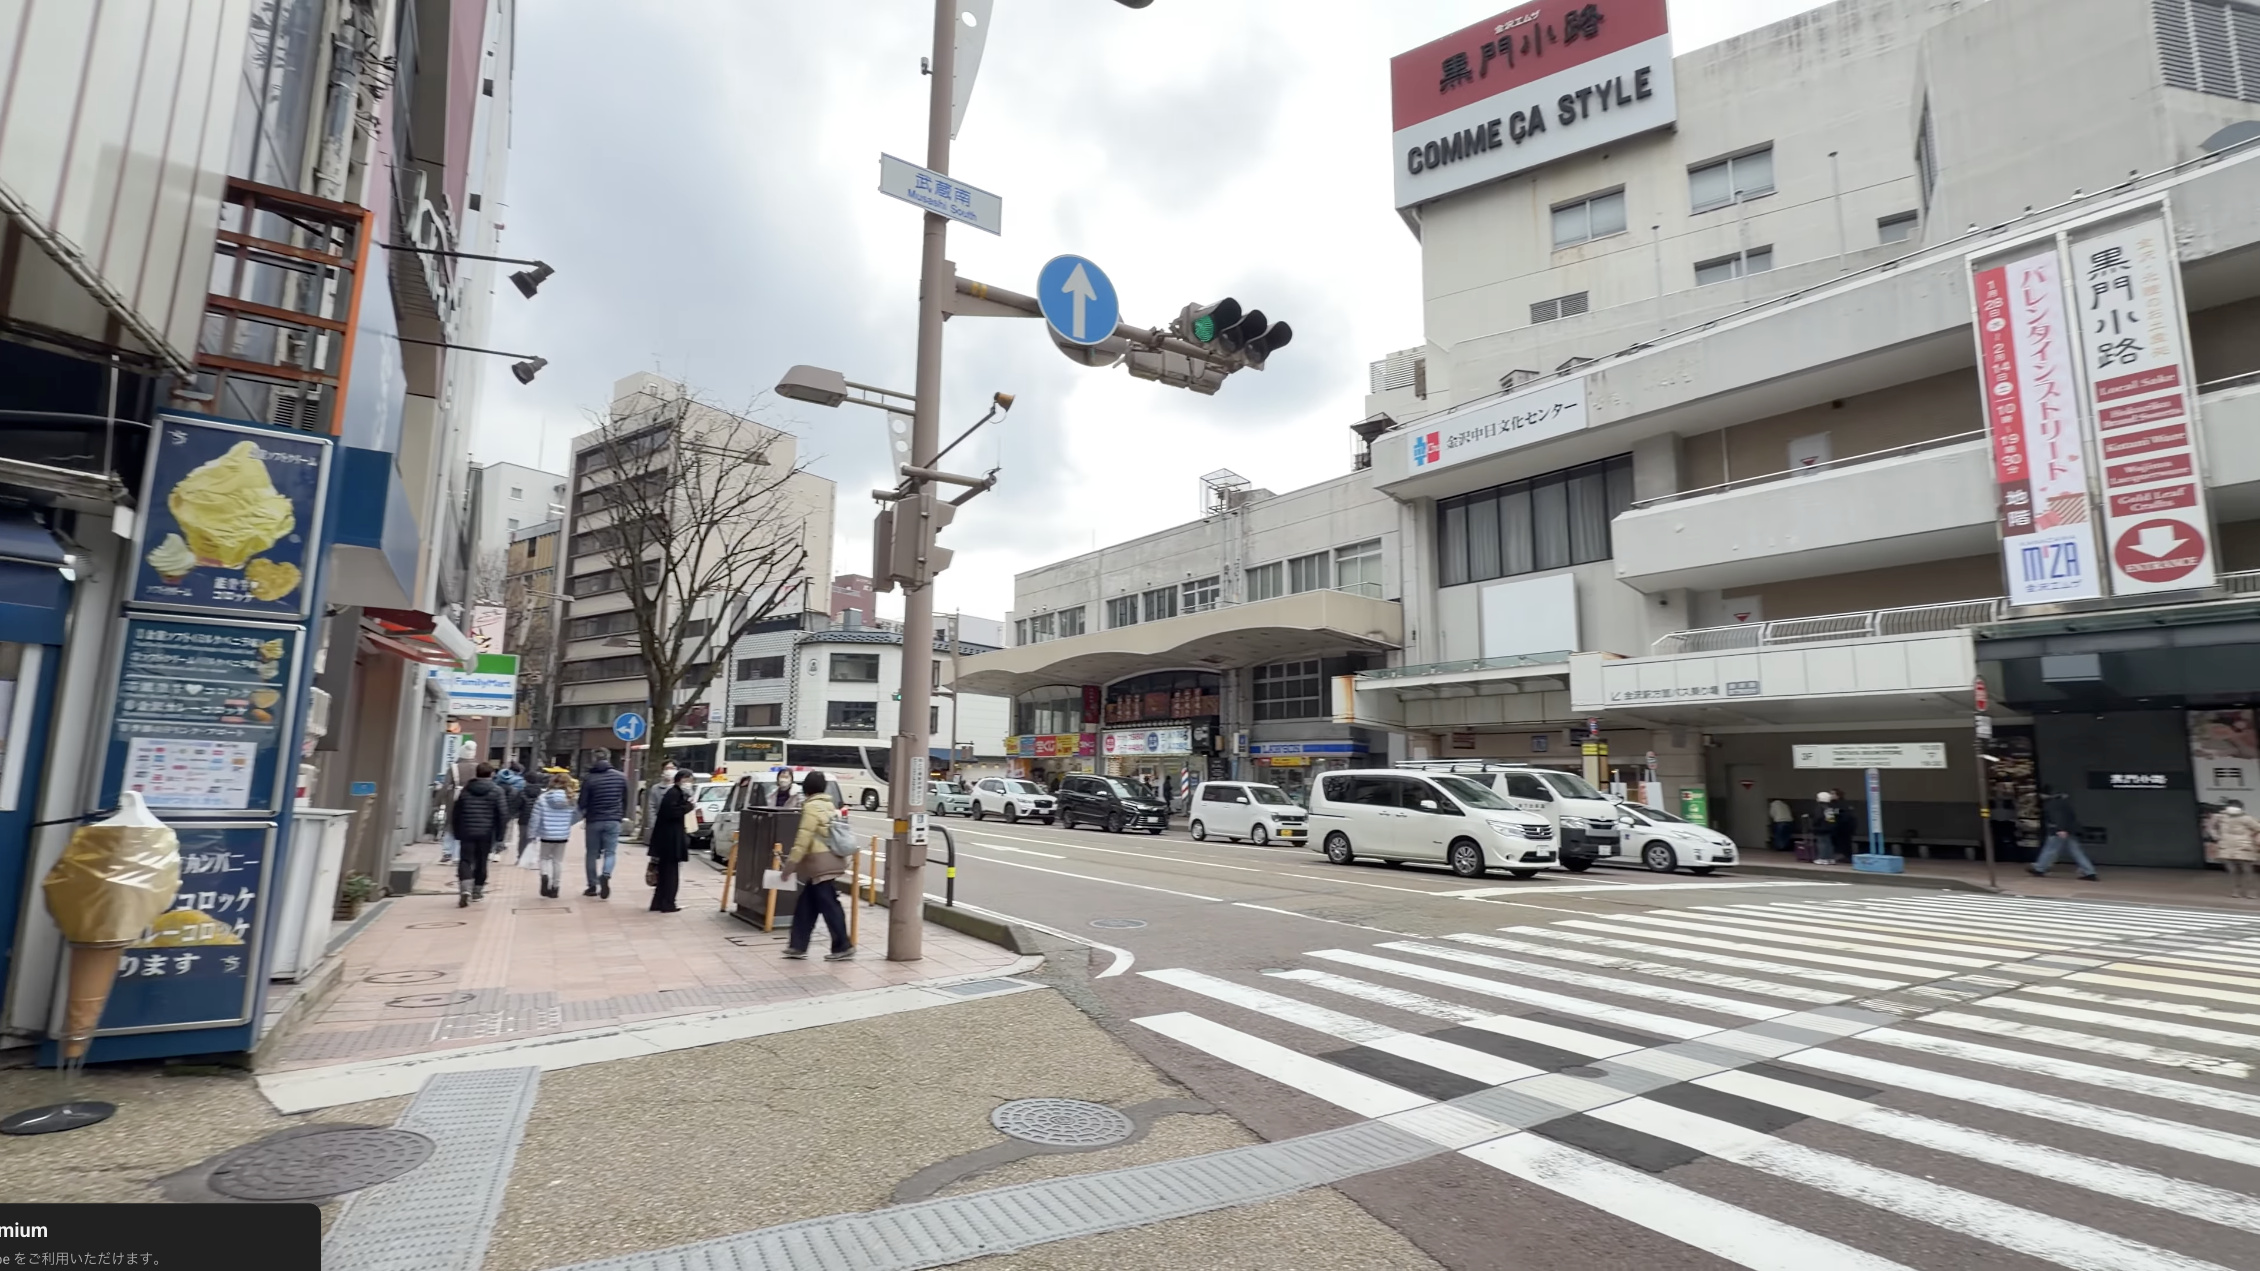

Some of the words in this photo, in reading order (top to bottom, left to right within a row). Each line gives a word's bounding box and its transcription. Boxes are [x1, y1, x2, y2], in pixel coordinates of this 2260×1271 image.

[1439, 3, 1605, 94] 黒門小路
[1407, 117, 1503, 175] COMME
[1509, 105, 1547, 145] ÇA
[1558, 66, 1653, 126] STYLE
[907, 189, 948, 210] Musashi
[950, 204, 978, 221] South
[915, 173, 971, 207] 武蔵南
[2087, 246, 2144, 369] 黒門小路
[2020, 264, 2068, 482] バレンタインストリート
[1446, 402, 1578, 449] 金沢中日文化センター
[2004, 488, 2032, 528] 地階
[170, 887, 256, 912] コロッケ
